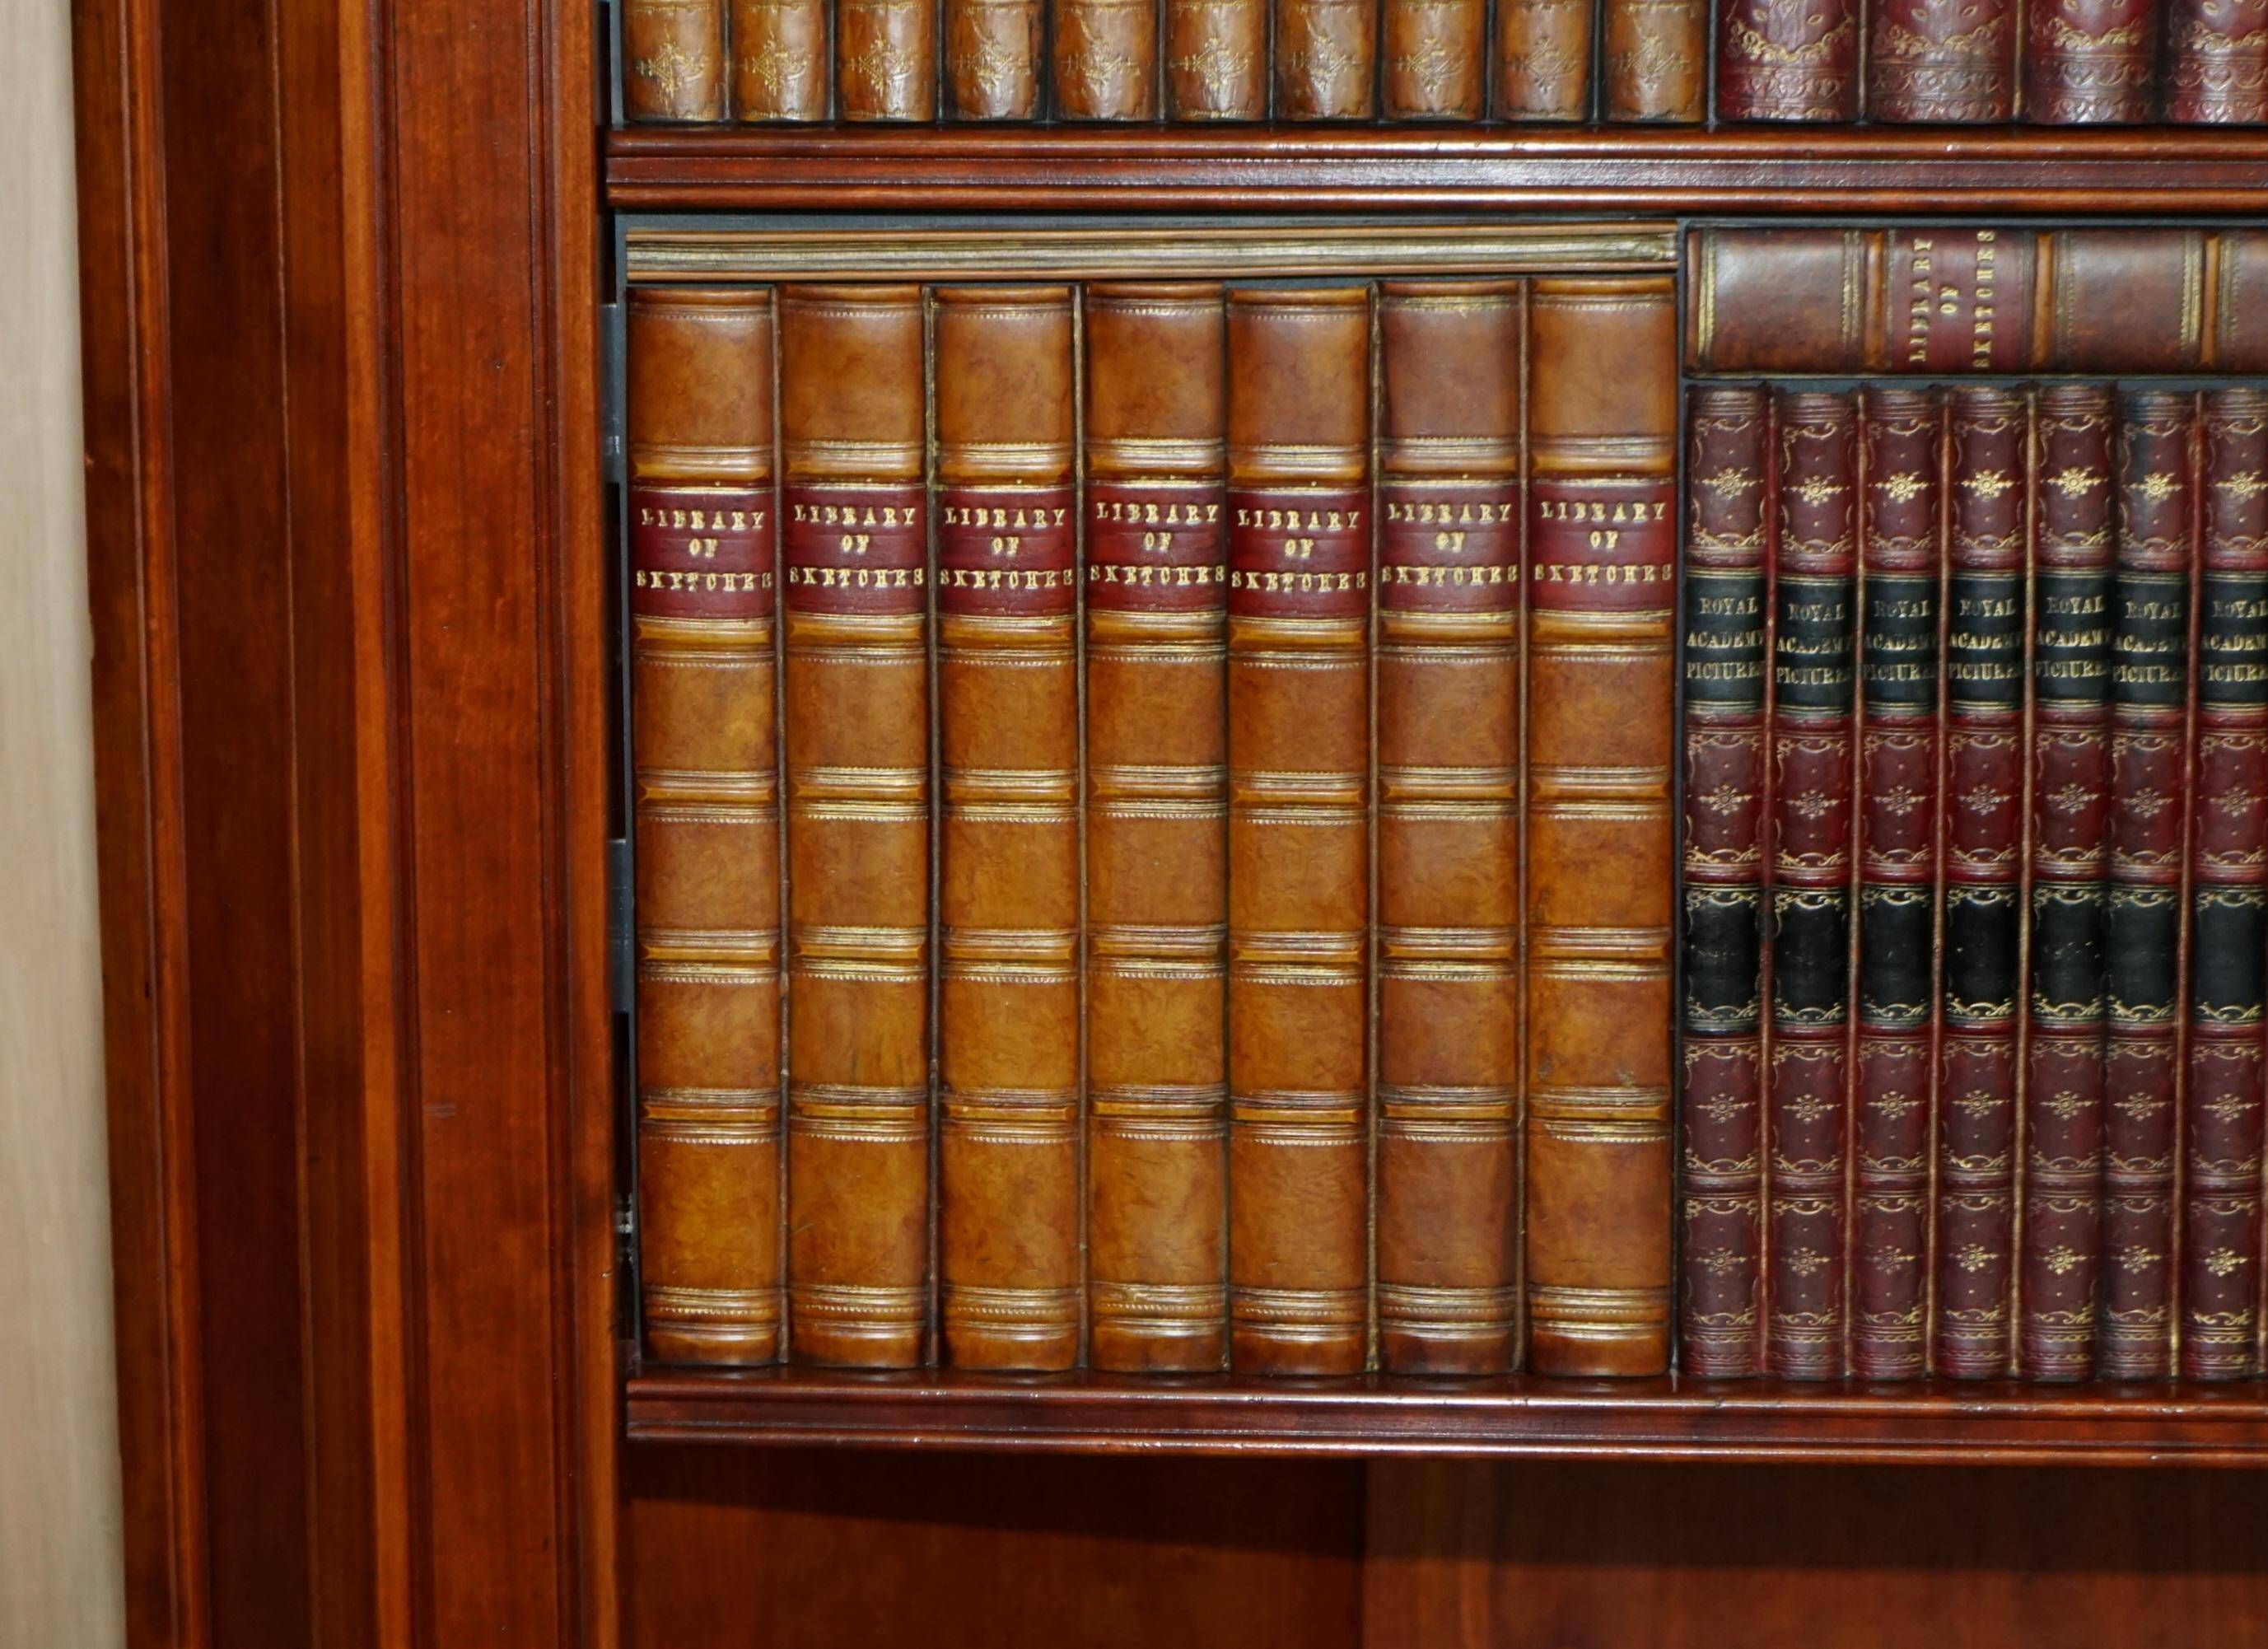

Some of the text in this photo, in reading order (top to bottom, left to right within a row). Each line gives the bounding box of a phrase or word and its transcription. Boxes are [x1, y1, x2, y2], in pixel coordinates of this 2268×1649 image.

[1909, 237, 1933, 362] LIBRARY
[1939, 286, 1958, 315] OF
[1972, 230, 1995, 367] SKETCHES
[642, 508, 764, 530] LIBRARY
[795, 504, 916, 527] LIBRARY
[945, 507, 1065, 528] LIBRARY
[1096, 502, 1218, 525] LIBRARY
[1237, 509, 1359, 531] LIBRARY
[1388, 503, 1511, 524] LIBRARY
[1541, 501, 1666, 523] LIBRARY
[688, 538, 718, 558] OF
[841, 534, 870, 554] OF
[992, 536, 1019, 556] OF
[1144, 532, 1172, 552] OF
[1285, 539, 1314, 558] OF
[1435, 531, 1465, 553] OF
[1590, 530, 1618, 549] OF
[637, 570, 772, 592] SKETCHES
[790, 567, 923, 587] SKETCHES
[940, 568, 1072, 590] SKETCHES
[1090, 564, 1225, 586] SKETCHES
[1231, 571, 1365, 592] SKETCHES
[1382, 564, 1517, 587] SKETCHES
[1534, 563, 1672, 585] SKETCHES
[1699, 596, 1757, 615] ROYAL
[1788, 603, 1845, 622] ROYAL
[1959, 598, 2016, 617] ROYAL
[2046, 595, 2105, 614] ROYAL
[2211, 600, 2267, 618] ROYAL
[2202, 633, 2267, 651] ACADEM
